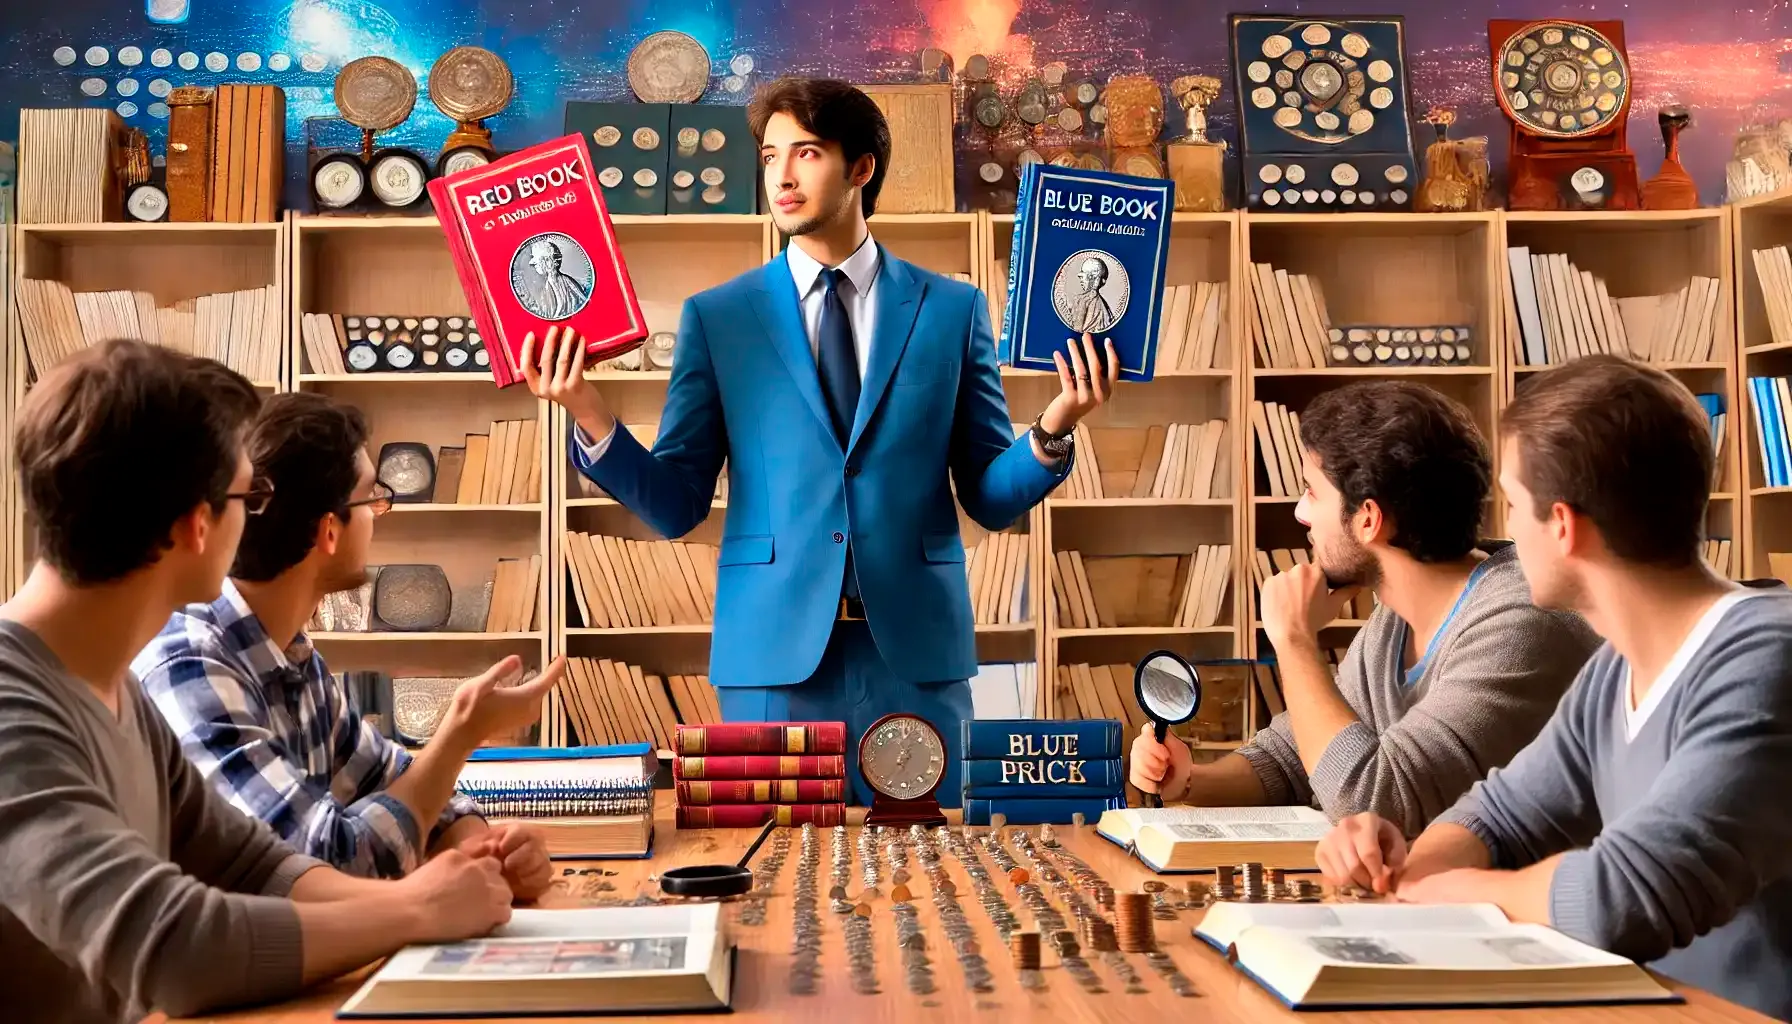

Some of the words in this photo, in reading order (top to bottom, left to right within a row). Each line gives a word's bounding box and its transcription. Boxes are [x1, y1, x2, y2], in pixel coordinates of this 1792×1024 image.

[516, 158, 583, 199] BOOK
[1043, 188, 1093, 213] BLUE
[1099, 194, 1159, 221] BOOK
[1005, 733, 1079, 756] BLUE
[998, 759, 1087, 784] PRICK
